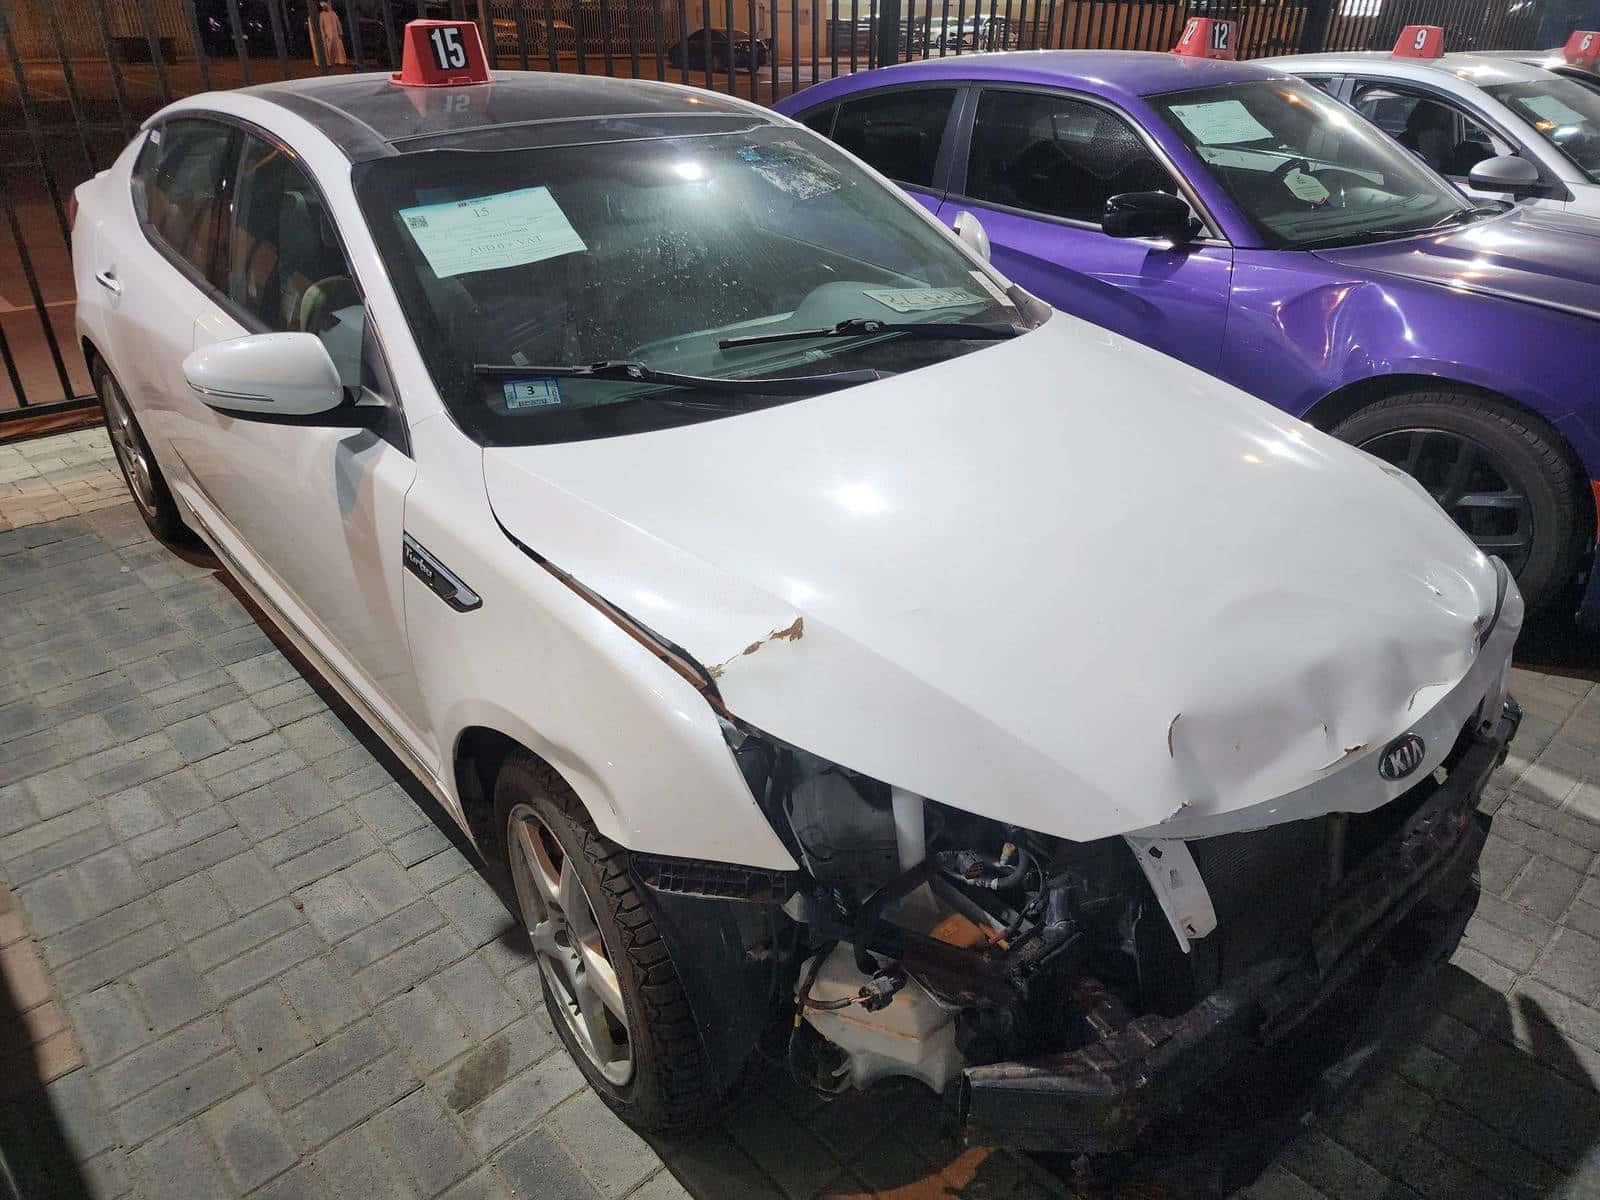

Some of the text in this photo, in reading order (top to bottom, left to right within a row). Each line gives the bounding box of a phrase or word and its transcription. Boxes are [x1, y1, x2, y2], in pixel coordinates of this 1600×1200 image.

[1214, 22, 1228, 49] 12
[1414, 29, 1428, 50] 9
[1580, 34, 1593, 50] 6
[431, 27, 466, 69] 15
[526, 385, 536, 396] 3
[1388, 739, 1423, 777] KIA
